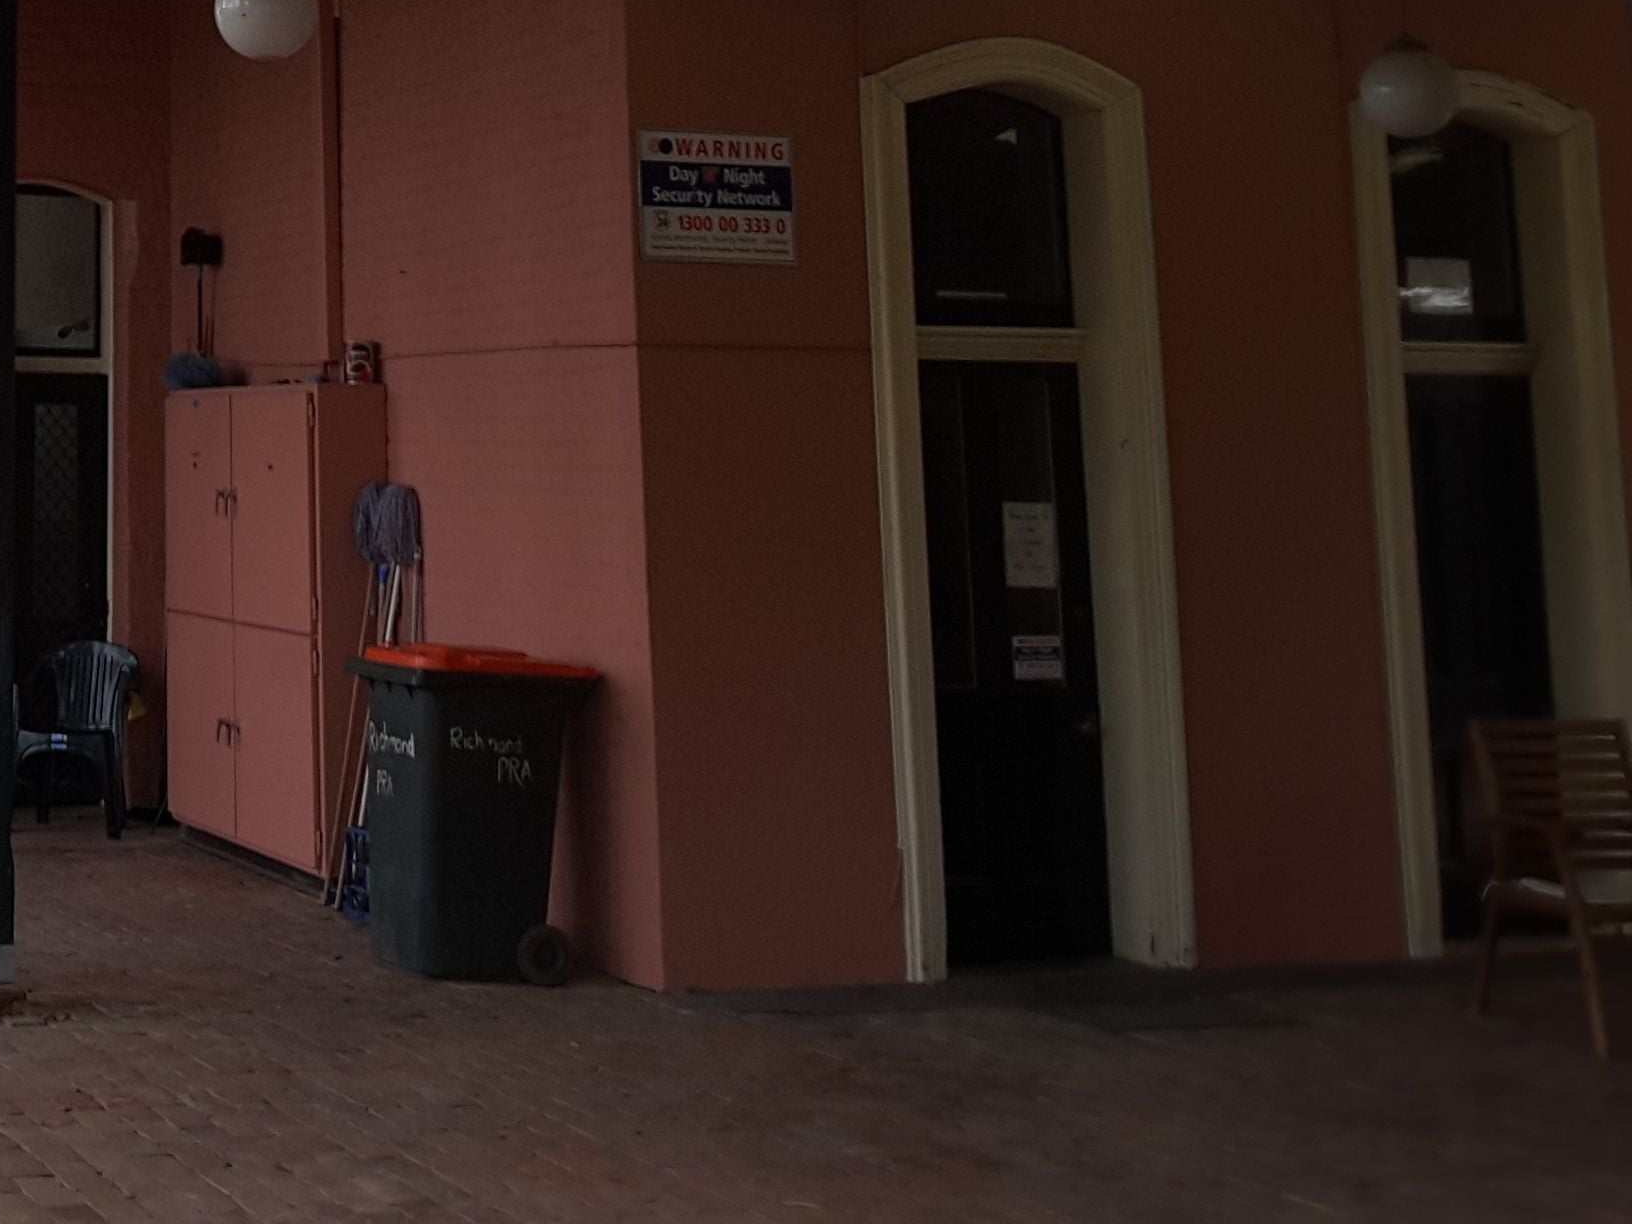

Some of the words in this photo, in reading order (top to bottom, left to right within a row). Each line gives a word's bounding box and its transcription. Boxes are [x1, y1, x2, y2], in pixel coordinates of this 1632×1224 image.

[675, 137, 785, 161] WARNING
[669, 165, 699, 185] Day
[723, 167, 767, 188] Night
[651, 186, 714, 207] Security
[716, 187, 782, 207] Network
[677, 215, 713, 231] 1300
[718, 216, 739, 232] 00
[743, 217, 770, 234] 333
[776, 218, 786, 234] 0
[376, 768, 395, 797] PRA
[497, 756, 534, 787] PRA
